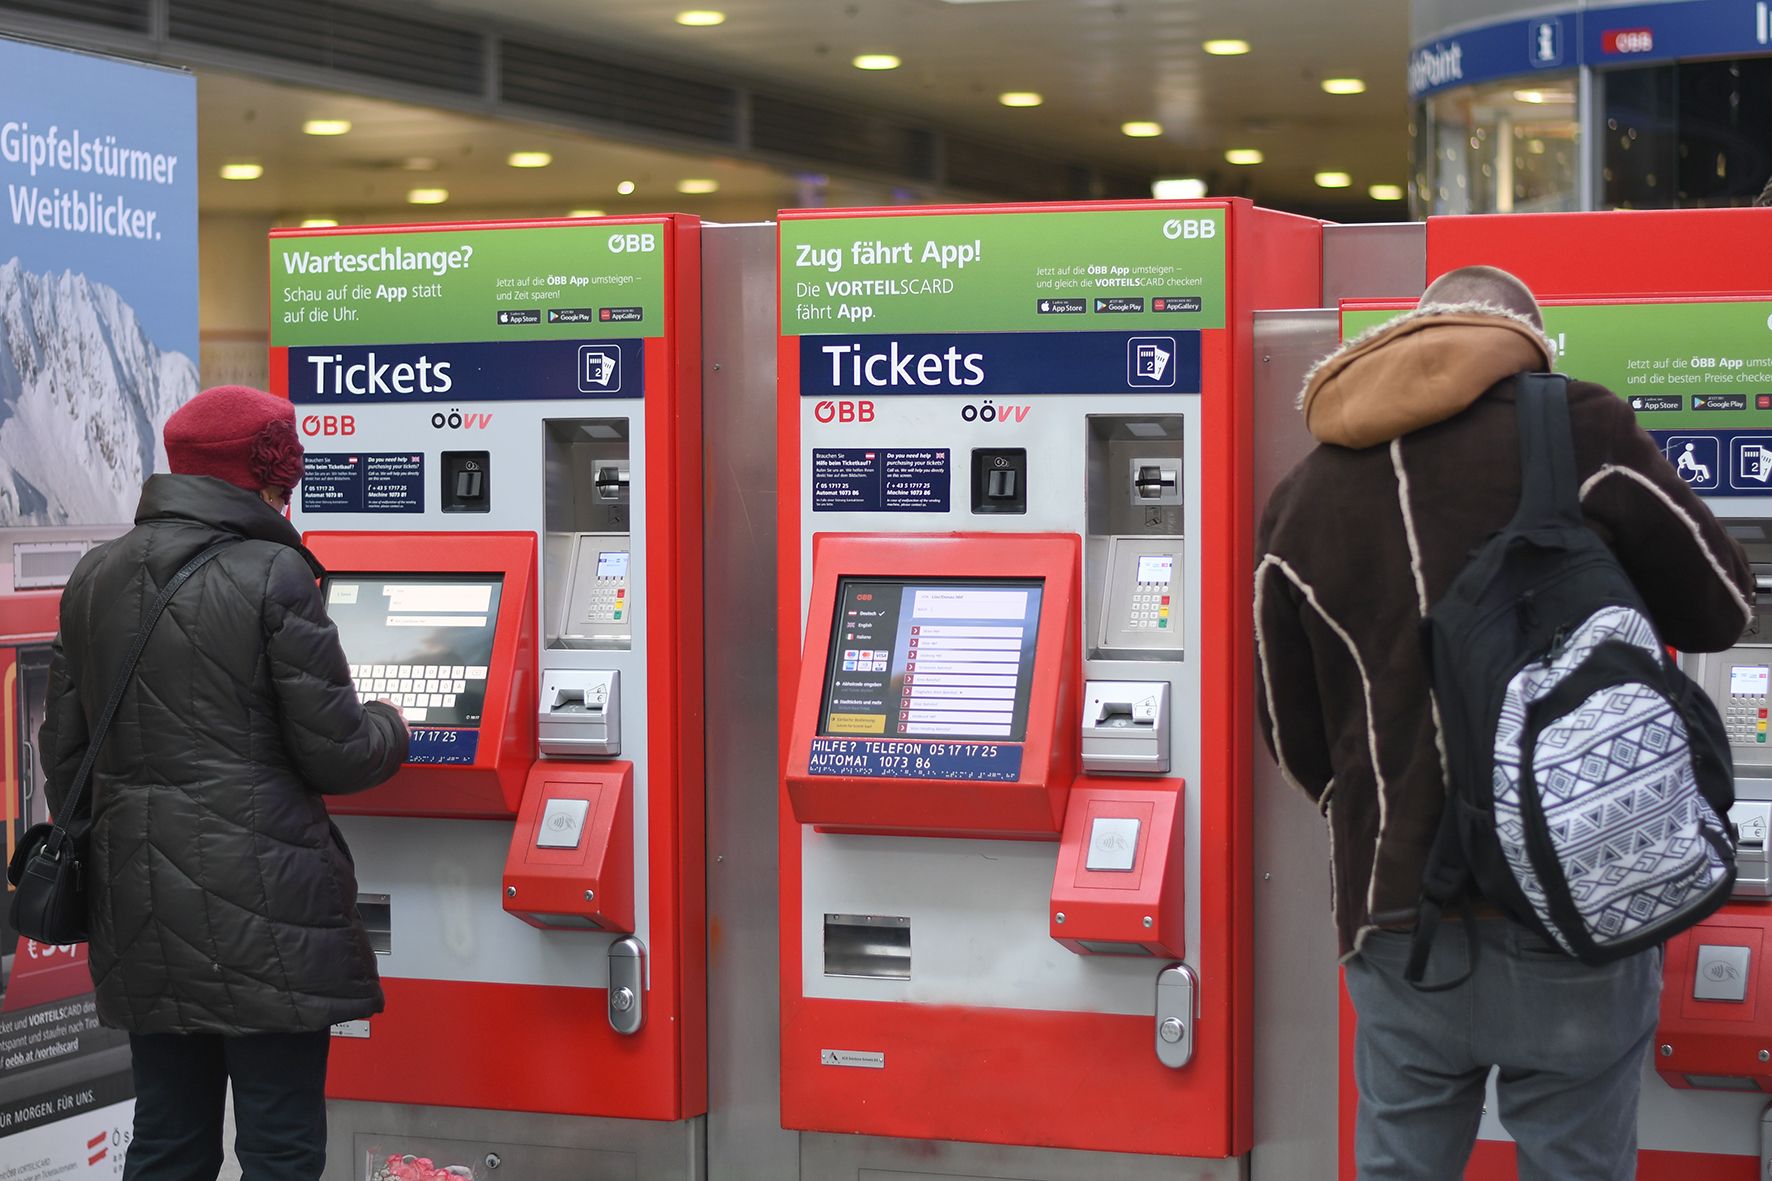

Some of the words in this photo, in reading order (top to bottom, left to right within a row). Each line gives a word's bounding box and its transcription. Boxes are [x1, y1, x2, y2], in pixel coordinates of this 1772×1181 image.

[1, 122, 177, 184] Gipfelstürmer
[9, 184, 161, 241] Weitblicker.
[1162, 219, 1216, 240] ÖBB
[608, 234, 656, 253] ÖBB
[283, 246, 473, 276] Warteschlange?
[796, 244, 842, 272] Zug
[851, 240, 913, 265] fährt
[921, 240, 981, 269] App!
[1036, 267, 1055, 276] Jetzt
[1057, 266, 1071, 275] auf
[1073, 266, 1085, 275] die
[1087, 264, 1107, 275] ÖBB
[1110, 266, 1130, 276] App
[1132, 264, 1174, 276] umsteigen
[496, 278, 515, 288] Jetzt
[517, 277, 530, 287] auf
[533, 277, 545, 286] die
[547, 275, 567, 286] ÖBB
[570, 276, 589, 287] App
[591, 275, 634, 286] umsteigen
[797, 282, 820, 298] Die
[825, 279, 954, 297] VORTEILSCARD
[1036, 280, 1052, 289] und
[1055, 279, 1078, 290] gleich
[1080, 279, 1093, 288] die
[1095, 277, 1164, 287] VORTEILSCARD
[1166, 277, 1202, 286] checken!
[284, 287, 322, 302] Schau
[327, 285, 348, 300] auf
[352, 285, 372, 299] die
[376, 285, 407, 303] App
[412, 284, 442, 298] statt
[496, 291, 512, 301] und
[514, 291, 529, 300] Zeit
[531, 290, 560, 301] sparen!
[284, 308, 305, 323] auf
[309, 308, 329, 322] die
[334, 307, 359, 322] Uhr.
[796, 304, 832, 320] fährt
[837, 304, 876, 323] App.
[1052, 305, 1065, 313] App
[1066, 304, 1082, 312] Store
[1108, 304, 1129, 312] Google
[822, 342, 985, 387] Tickets
[1627, 360, 1650, 369] Jetzt
[1653, 358, 1670, 368] auf
[1672, 358, 1687, 368] die
[1690, 356, 1715, 367] ÖBB
[1719, 358, 1743, 370] App
[1746, 357, 1772, 367] umst
[308, 353, 453, 394] Tickets
[1627, 374, 1646, 384] und
[1649, 374, 1665, 384] die
[1668, 373, 1701, 383] besten
[1704, 372, 1733, 383] Preise
[1736, 372, 1772, 383] checke
[814, 400, 875, 424] ÖBB
[1644, 402, 1657, 410] App
[1707, 401, 1729, 410] Google
[1729, 401, 1743, 409] Play
[302, 415, 356, 437] ÖBB
[427, 731, 441, 742] 17
[442, 731, 457, 743] 25
[865, 742, 922, 755] TELEFON
[929, 743, 945, 756] 05
[948, 744, 961, 757] 17
[965, 745, 979, 757] 17
[981, 745, 998, 758] 25
[879, 756, 908, 769] 1073
[915, 757, 931, 769] 86
[28, 1003, 82, 1027] VORTEILSCARD
[82, 1001, 97, 1014] dire
[14, 1101, 56, 1123] MORGEN.
[57, 1094, 74, 1111] FÜR
[75, 1090, 96, 1107] UNS.
